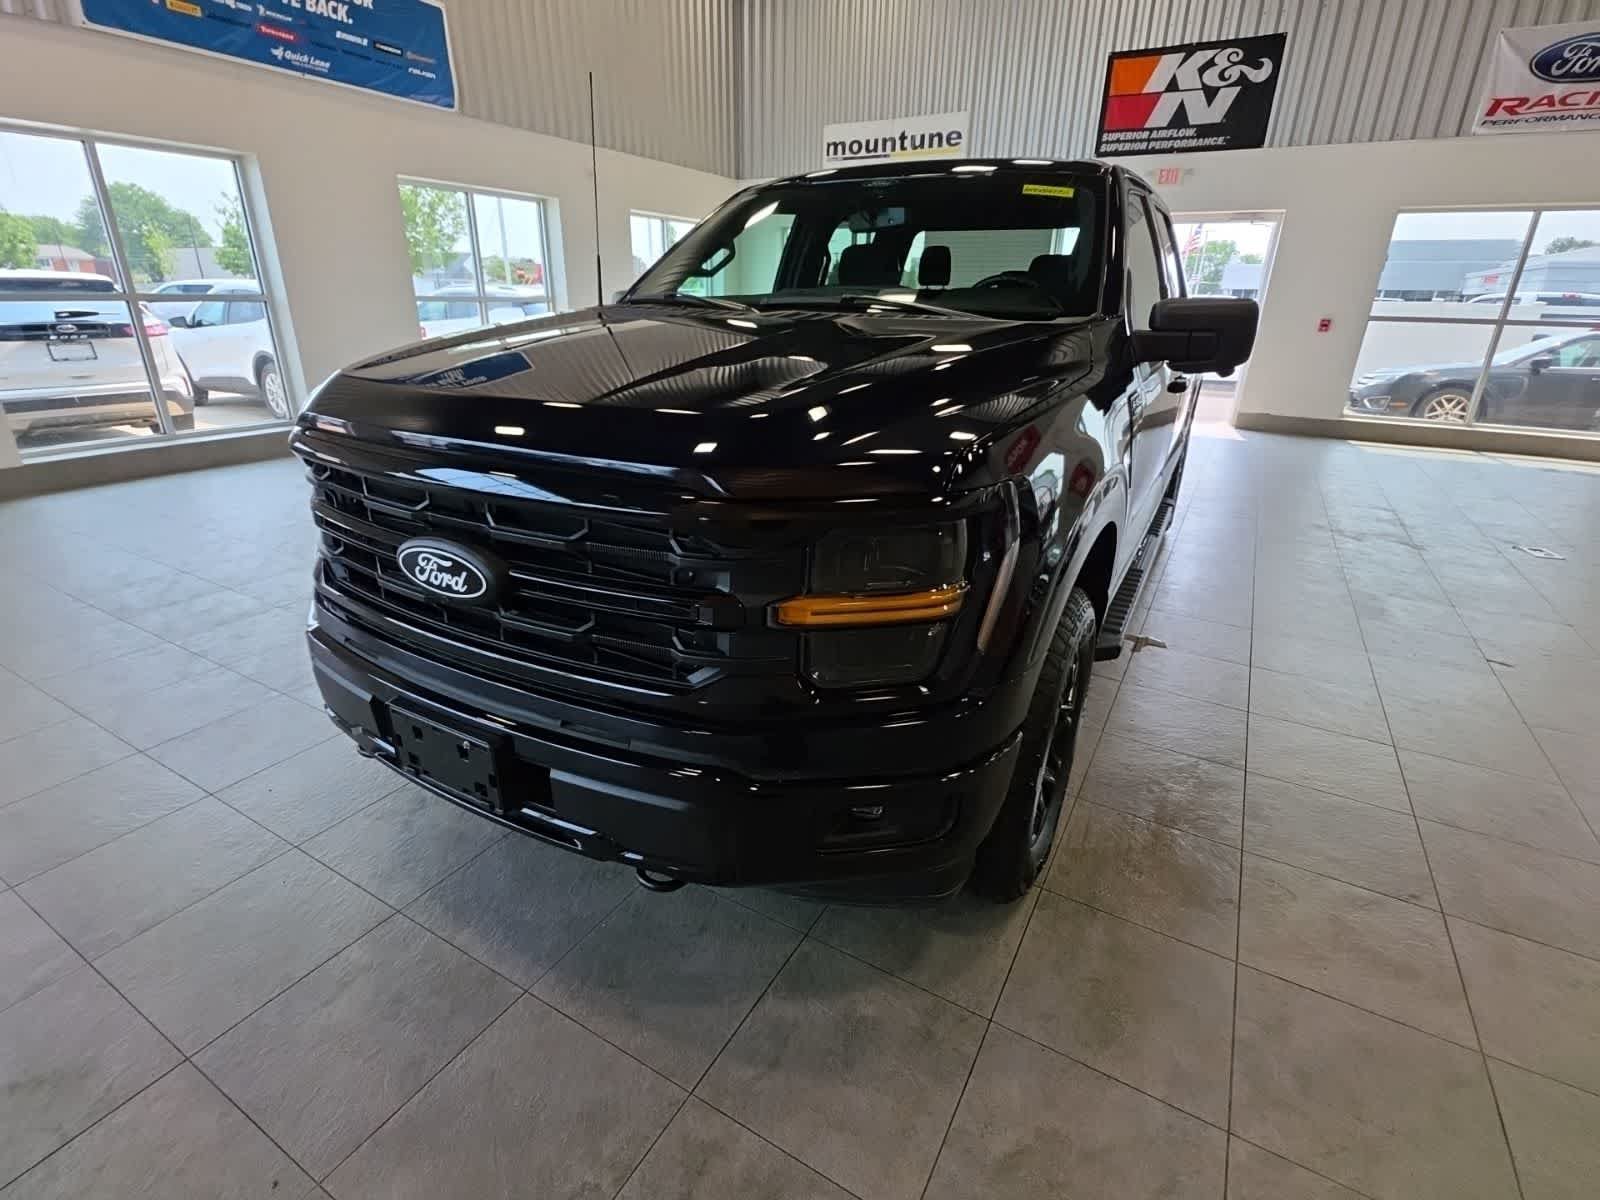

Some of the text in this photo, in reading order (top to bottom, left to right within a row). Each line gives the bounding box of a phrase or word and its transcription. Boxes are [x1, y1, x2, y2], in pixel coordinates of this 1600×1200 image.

[305, 0, 353, 25] BACK.
[284, 49, 309, 63] Quick
[309, 56, 331, 69] Lane
[826, 129, 962, 157] mountune
[1102, 128, 1197, 142] SUPERIOR AIRFLOW.
[1100, 141, 1147, 153] SUPERIOR
[1157, 168, 1178, 185] EXIT
[415, 553, 468, 593] Ford
